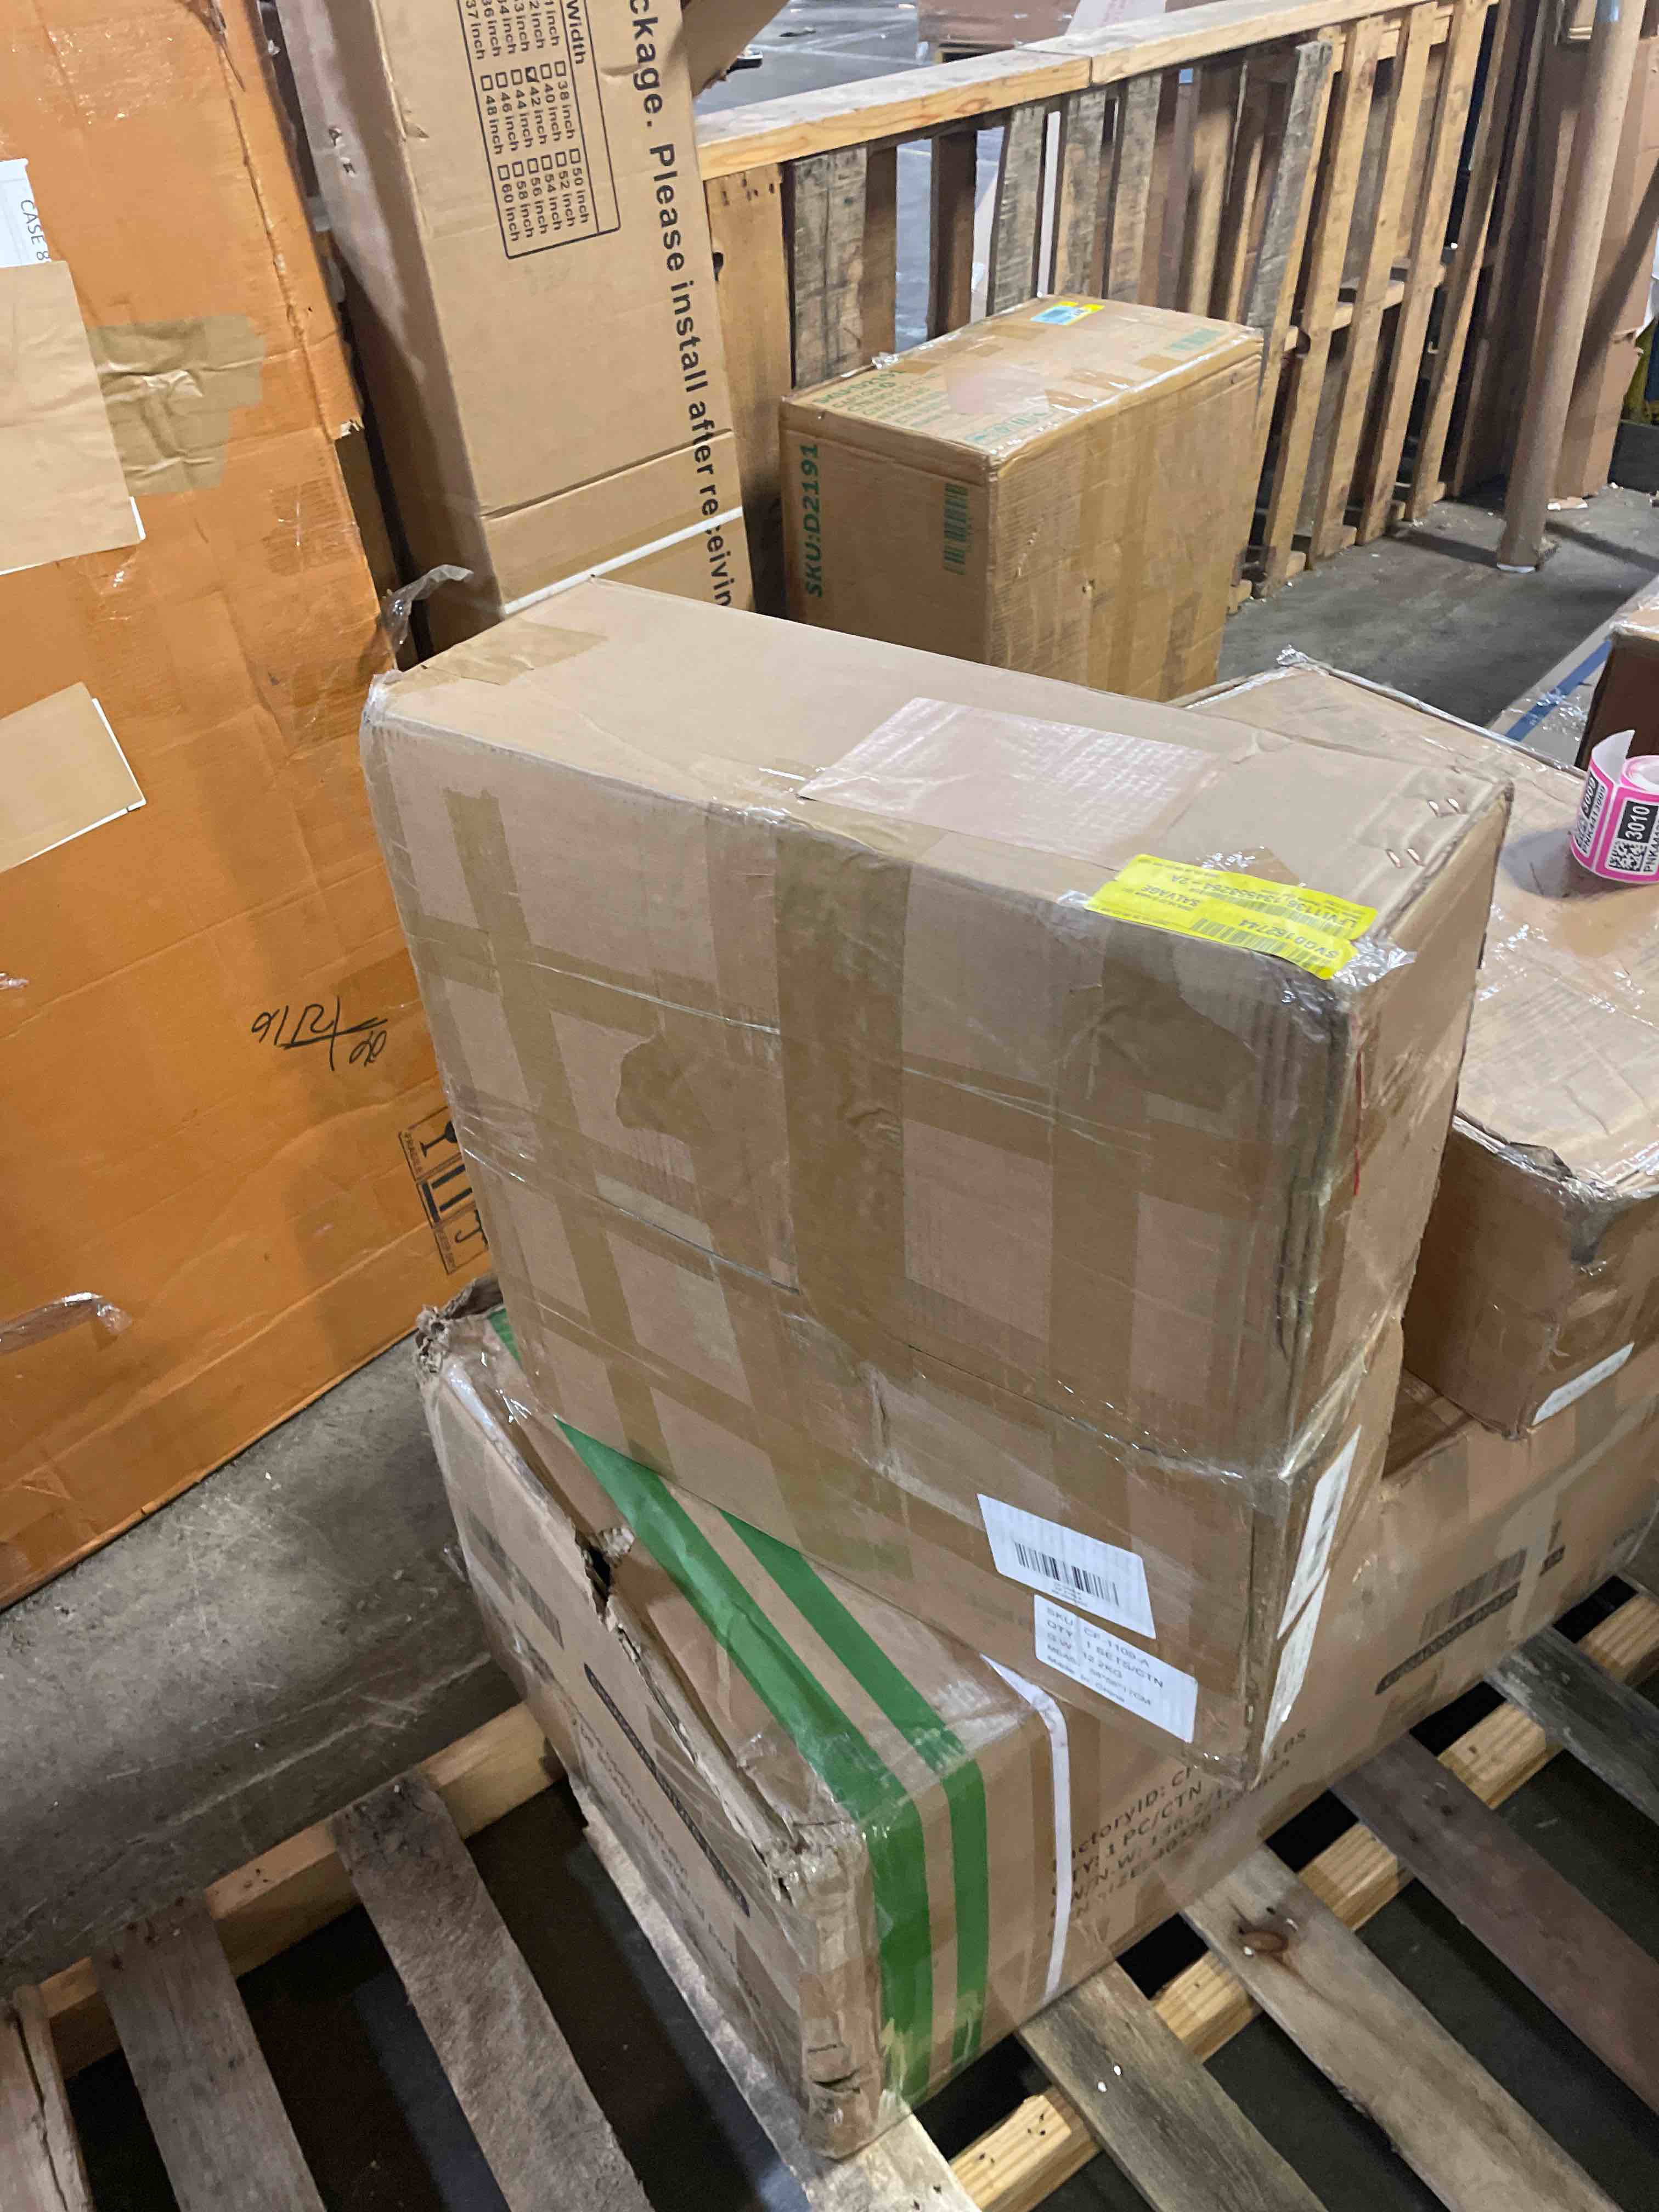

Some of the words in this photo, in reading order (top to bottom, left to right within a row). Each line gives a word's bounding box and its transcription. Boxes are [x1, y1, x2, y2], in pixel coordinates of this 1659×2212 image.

[466, 0, 479, 19] 37
[514, 0, 524, 12] 3
[471, 23, 486, 60] inch
[488, 20, 501, 57] inch
[503, 18, 516, 54] inch
[516, 15, 531, 52] inch
[532, 13, 546, 49] inch
[486, 95, 497, 116] 48
[501, 92, 512, 112] 46
[516, 89, 527, 109] 44
[530, 86, 541, 107] 42
[545, 83, 556, 103] 40
[558, 81, 570, 100] 38
[489, 119, 504, 155] inch
[505, 115, 520, 151] inch
[520, 113, 534, 148] inch
[534, 109, 548, 145] inch
[549, 106, 562, 142] inch
[562, 104, 575, 139] inch
[516, 181, 528, 200] 58
[531, 177, 543, 196] 56
[545, 174, 556, 193] 54
[558, 171, 571, 190] 52
[573, 167, 584, 186] 50
[501, 184, 514, 204] 60
[562, 194, 576, 227] inch
[577, 189, 590, 223] inch
[20, 199, 45, 245] CASE
[505, 207, 520, 242] inch
[520, 204, 534, 238] inch
[534, 200, 548, 234] inch
[549, 196, 562, 230] inch
[650, 144, 685, 272] Please
[671, 280, 709, 392] install
[800, 444, 822, 598] SKU:D2191
[1625, 805, 1651, 840] 3010
